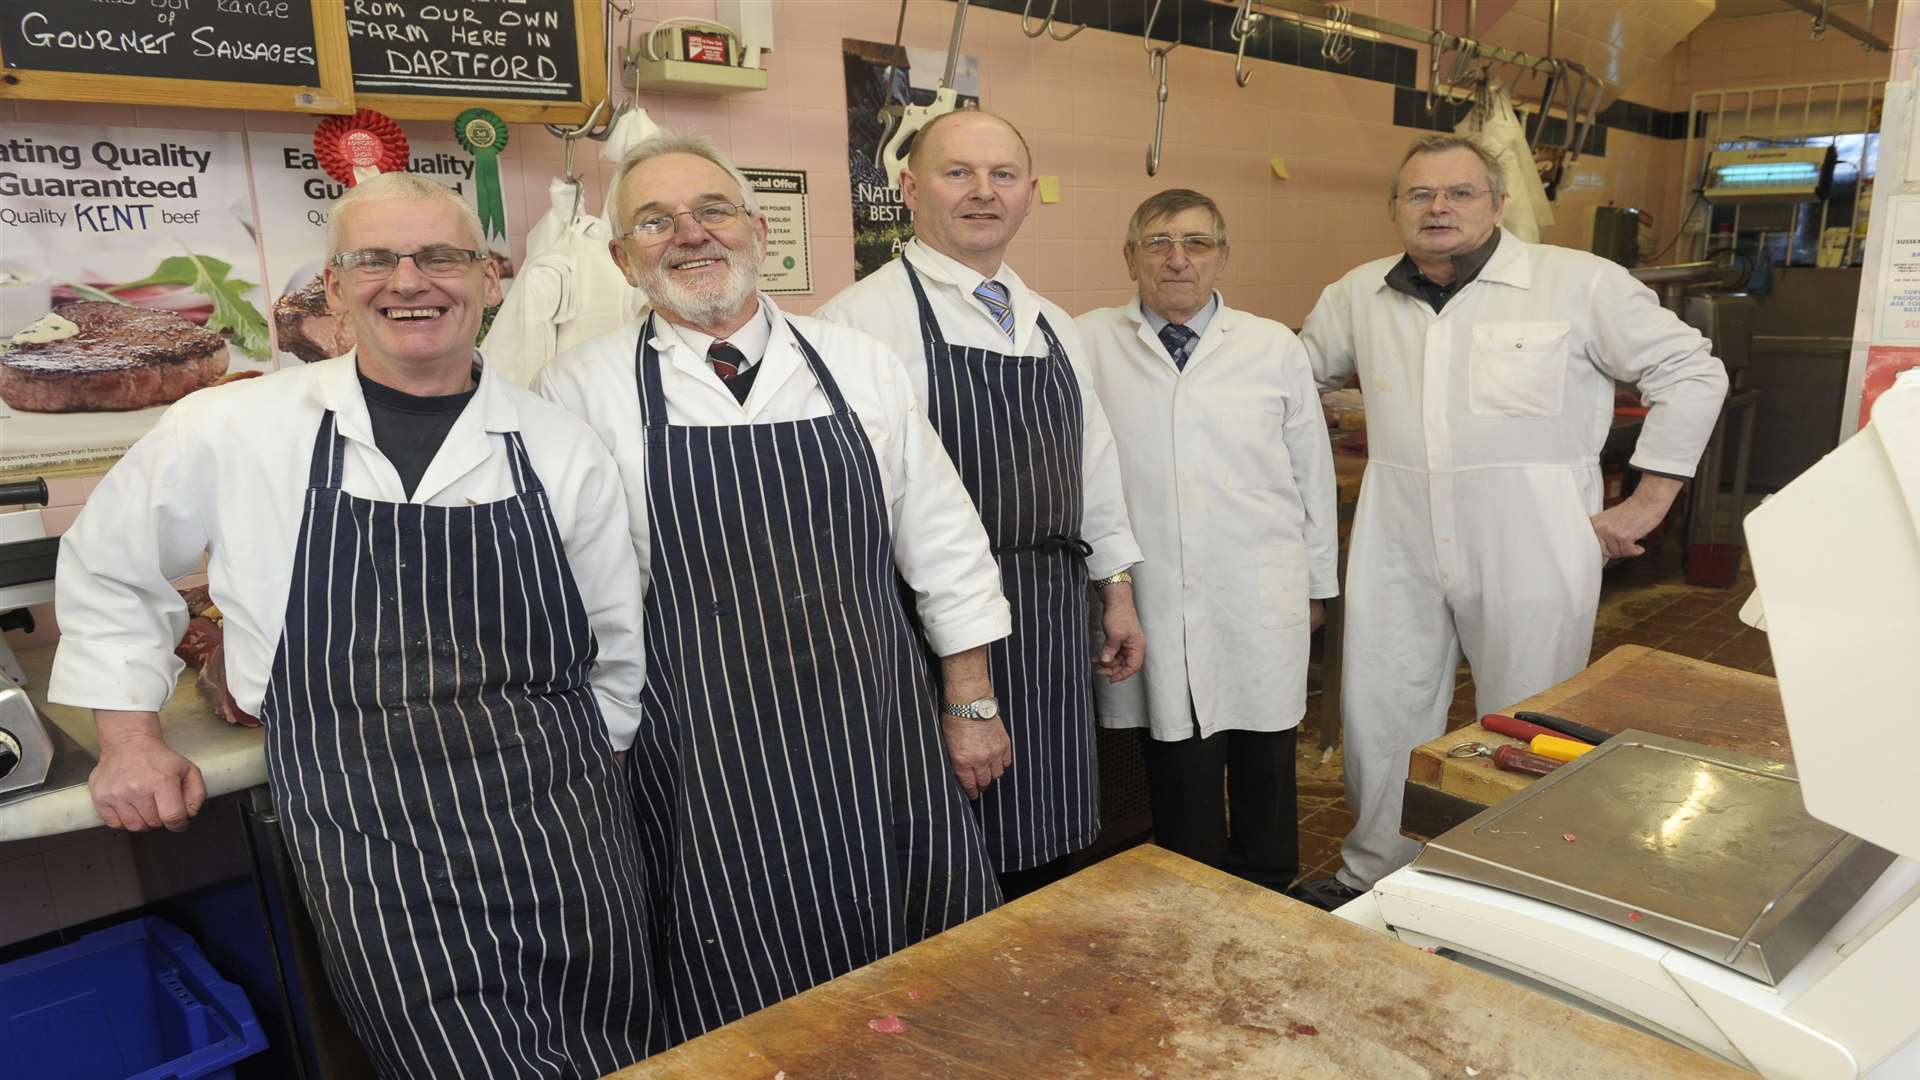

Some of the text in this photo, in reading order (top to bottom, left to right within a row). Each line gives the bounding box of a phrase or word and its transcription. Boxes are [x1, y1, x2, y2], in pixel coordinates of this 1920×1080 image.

[158, 11, 176, 26] of
[345, 0, 558, 29] ROM OUR OWN
[21, 12, 315, 65] GOURMET SAUSAGES
[347, 20, 551, 47] FARM HERE IN
[386, 49, 557, 81] DARTFORD
[0, 138, 211, 173] ating Quality
[405, 153, 475, 179] uality
[0, 172, 198, 198] Guaranteed
[751, 178, 798, 189] ecial Offer
[858, 183, 904, 204] NATU
[0, 203, 200, 232] Quality KENT beef
[870, 205, 903, 221] BEST
